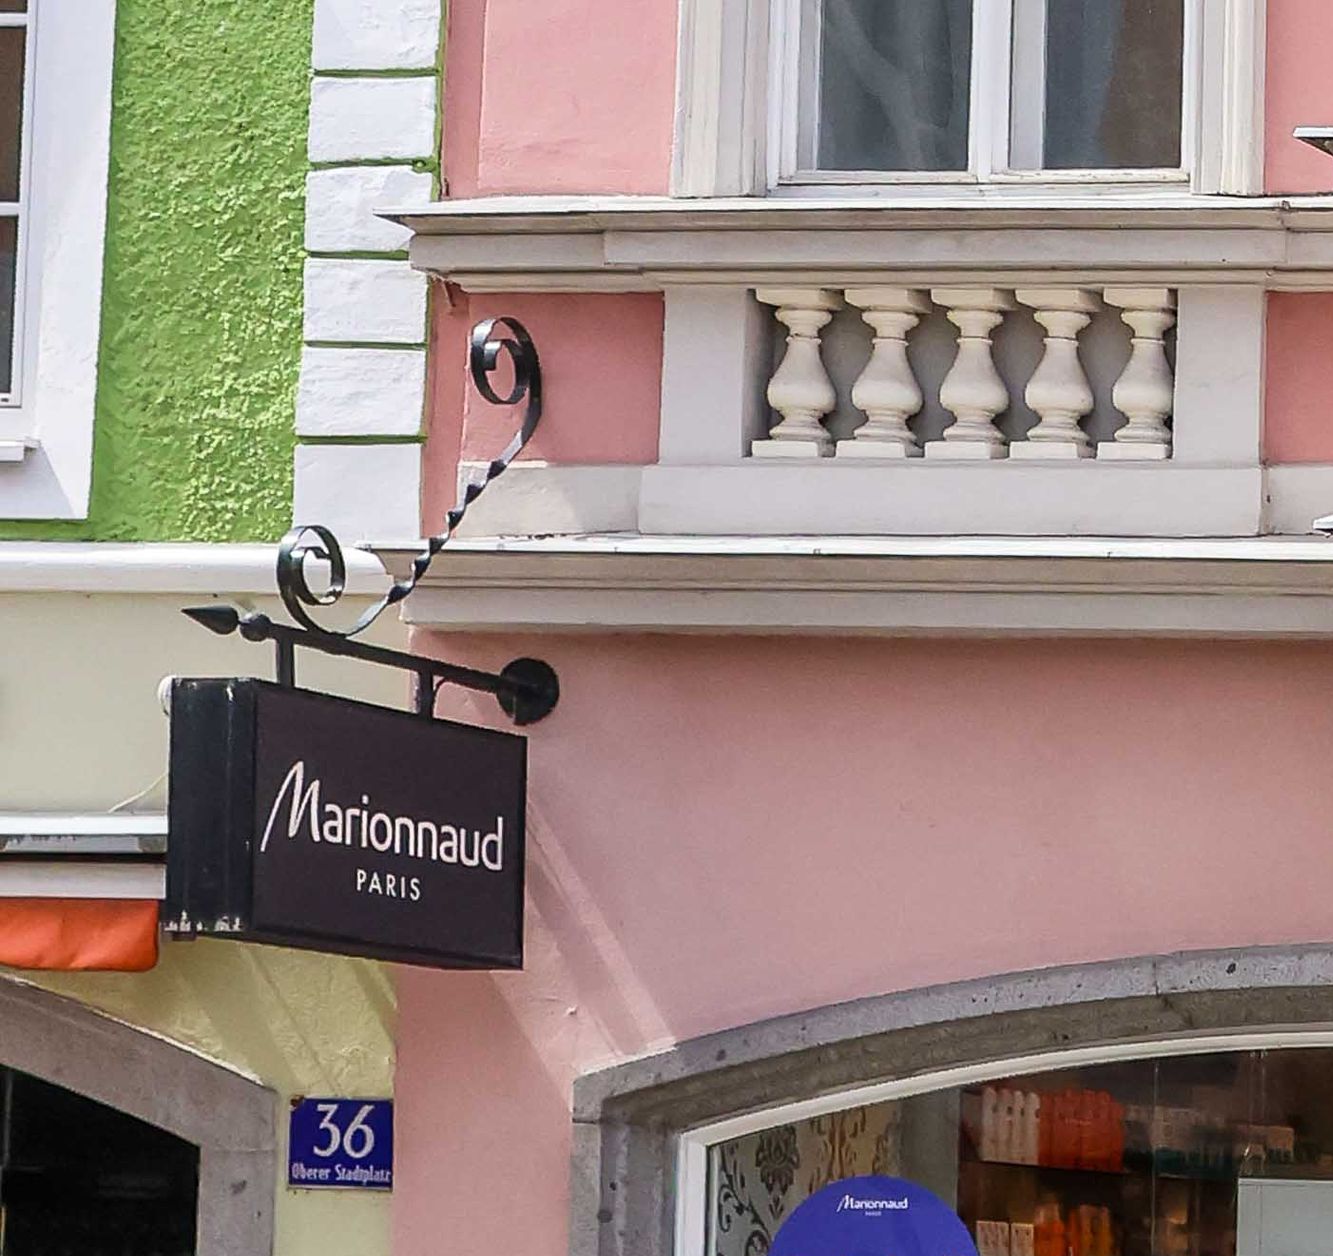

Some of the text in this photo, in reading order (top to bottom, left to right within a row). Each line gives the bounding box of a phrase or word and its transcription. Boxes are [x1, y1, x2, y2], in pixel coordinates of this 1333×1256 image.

[261, 761, 503, 871] Marionnaud
[357, 868, 420, 901] PARIS
[313, 1104, 375, 1158] 36
[292, 1162, 331, 1179] Oberer
